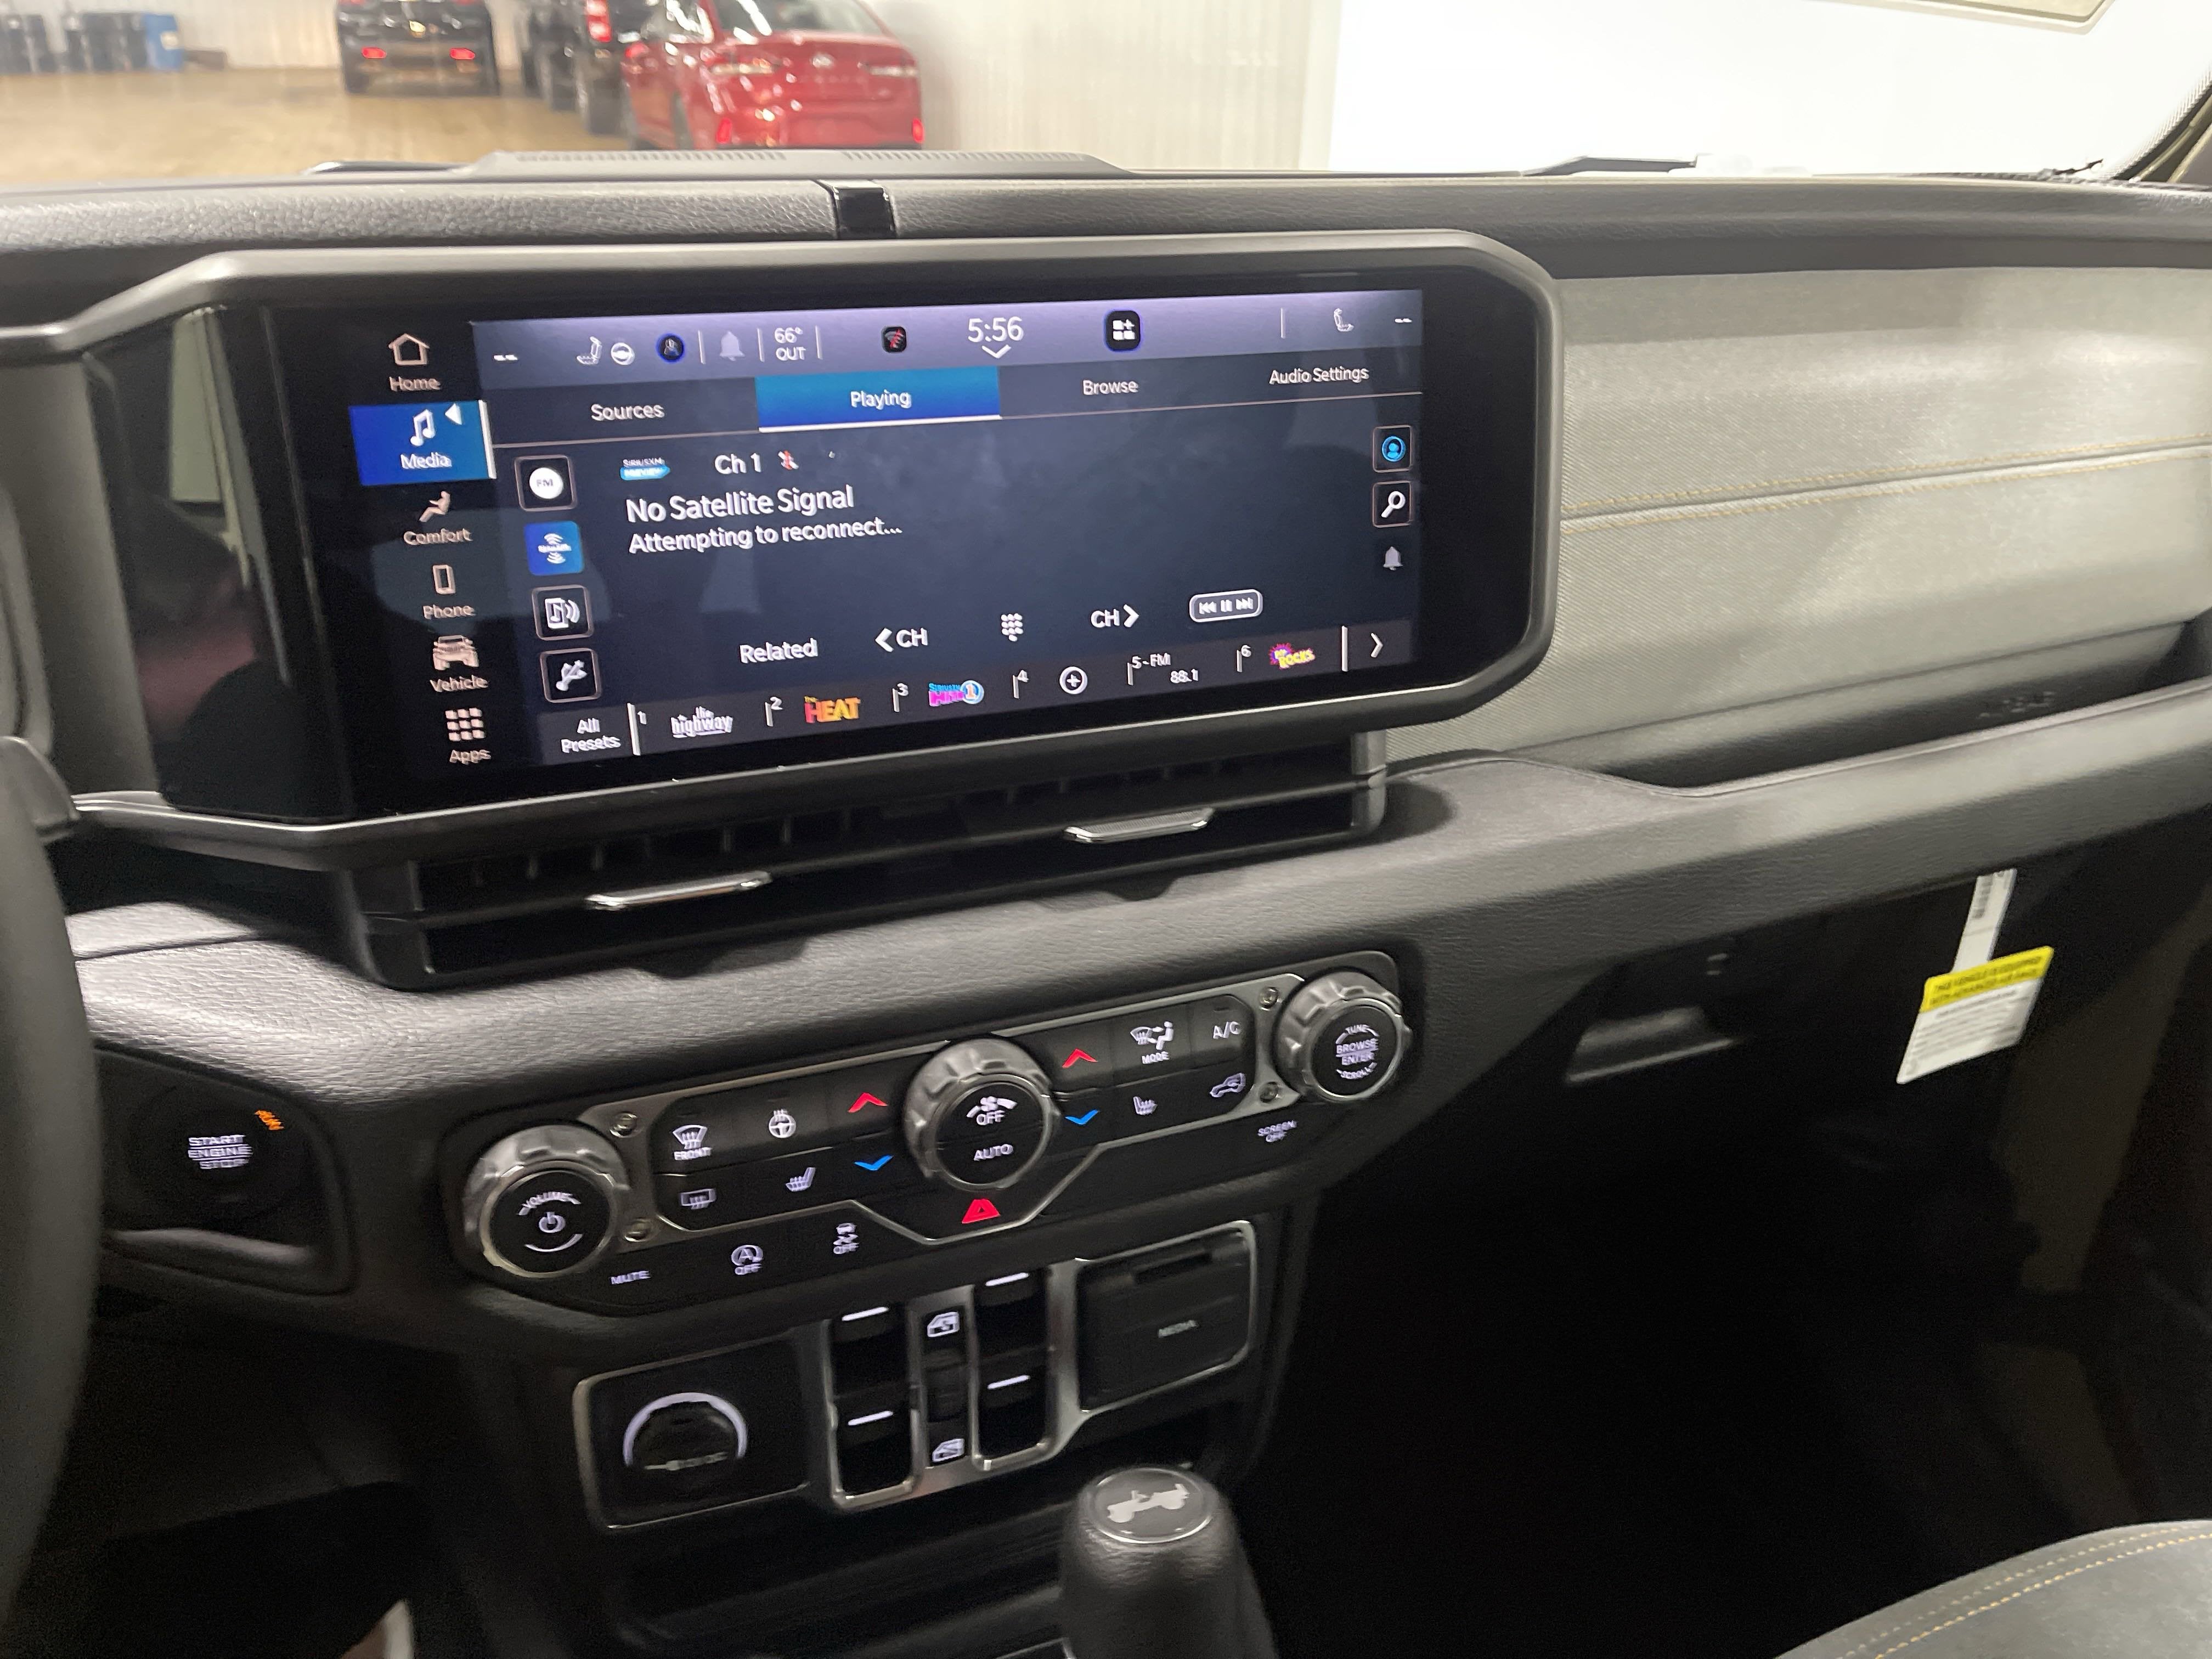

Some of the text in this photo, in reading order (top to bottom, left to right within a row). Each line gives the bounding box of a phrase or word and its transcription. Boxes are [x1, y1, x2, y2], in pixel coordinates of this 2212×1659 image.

[967, 316, 1024, 343] 5:56
[776, 346, 806, 362] OUT
[390, 376, 441, 391] Home
[1269, 366, 1369, 386] Audio Settings
[1082, 379, 1139, 396] Browse
[850, 390, 912, 410] Playing
[591, 404, 664, 421] Sources
[400, 453, 452, 470] Media
[715, 453, 761, 475] Ch 1
[537, 478, 553, 487] FM
[626, 484, 854, 523] No Satellite Signal
[404, 528, 473, 546] Comfort
[628, 517, 902, 554] Attempting to reconnect...
[423, 605, 476, 620] Phone
[1091, 608, 1120, 629] CH
[895, 628, 928, 647] CH
[740, 637, 819, 664] Related
[1241, 645, 1252, 658] 6
[430, 675, 489, 692] Vehicle
[1017, 669, 1029, 684] 4
[1170, 668, 1199, 684] 88.1
[896, 683, 909, 697] 3
[966, 684, 976, 699] 1
[769, 696, 783, 710] 2
[804, 697, 861, 724] HEAT
[577, 718, 600, 734] All
[670, 714, 733, 738] highway
[561, 735, 621, 753] Presets
[449, 749, 491, 765] Apps
[1212, 1021, 1242, 1040] A/C
[1345, 1024, 1369, 1035] TUNE
[1336, 1038, 1378, 1053] BROWSE
[1142, 1051, 1170, 1064] MODE
[976, 1110, 1005, 1126] OFF
[188, 1134, 246, 1146] START
[188, 1146, 253, 1159] ENGINE
[674, 1147, 712, 1160] FRONT
[973, 1143, 1014, 1161] AUTO
[199, 1158, 250, 1170] STOP
[522, 1191, 573, 1209] VOLUME
[610, 1270, 651, 1285] MUTE
